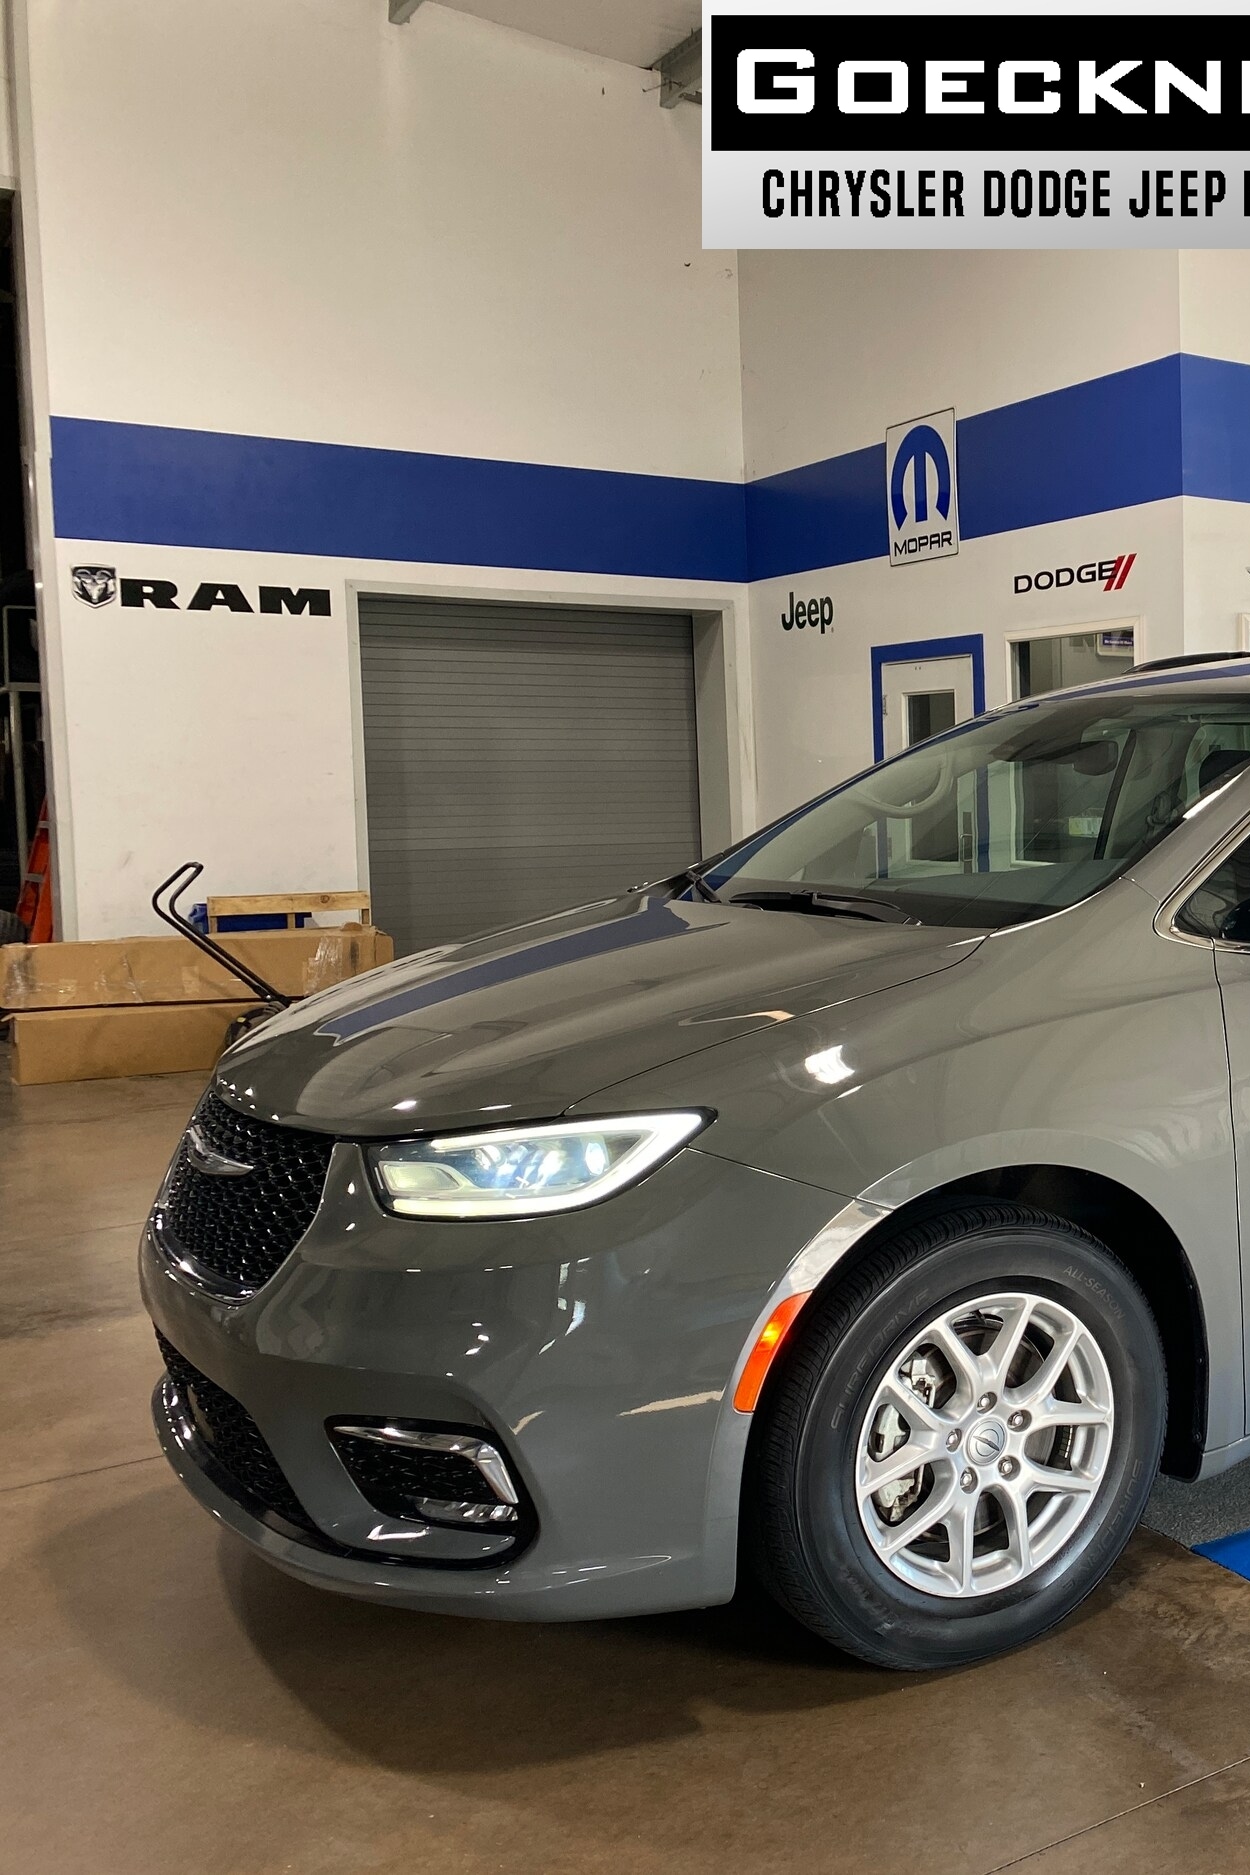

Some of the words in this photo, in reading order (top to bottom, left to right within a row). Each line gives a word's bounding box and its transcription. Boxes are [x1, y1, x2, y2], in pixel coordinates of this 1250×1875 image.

[894, 530, 953, 557] MOPAR
[1013, 559, 1118, 594] DODGE
[120, 578, 332, 617] RAM
[781, 591, 834, 634] Jeep
[1062, 1265, 1127, 1320] ALL-SEASON
